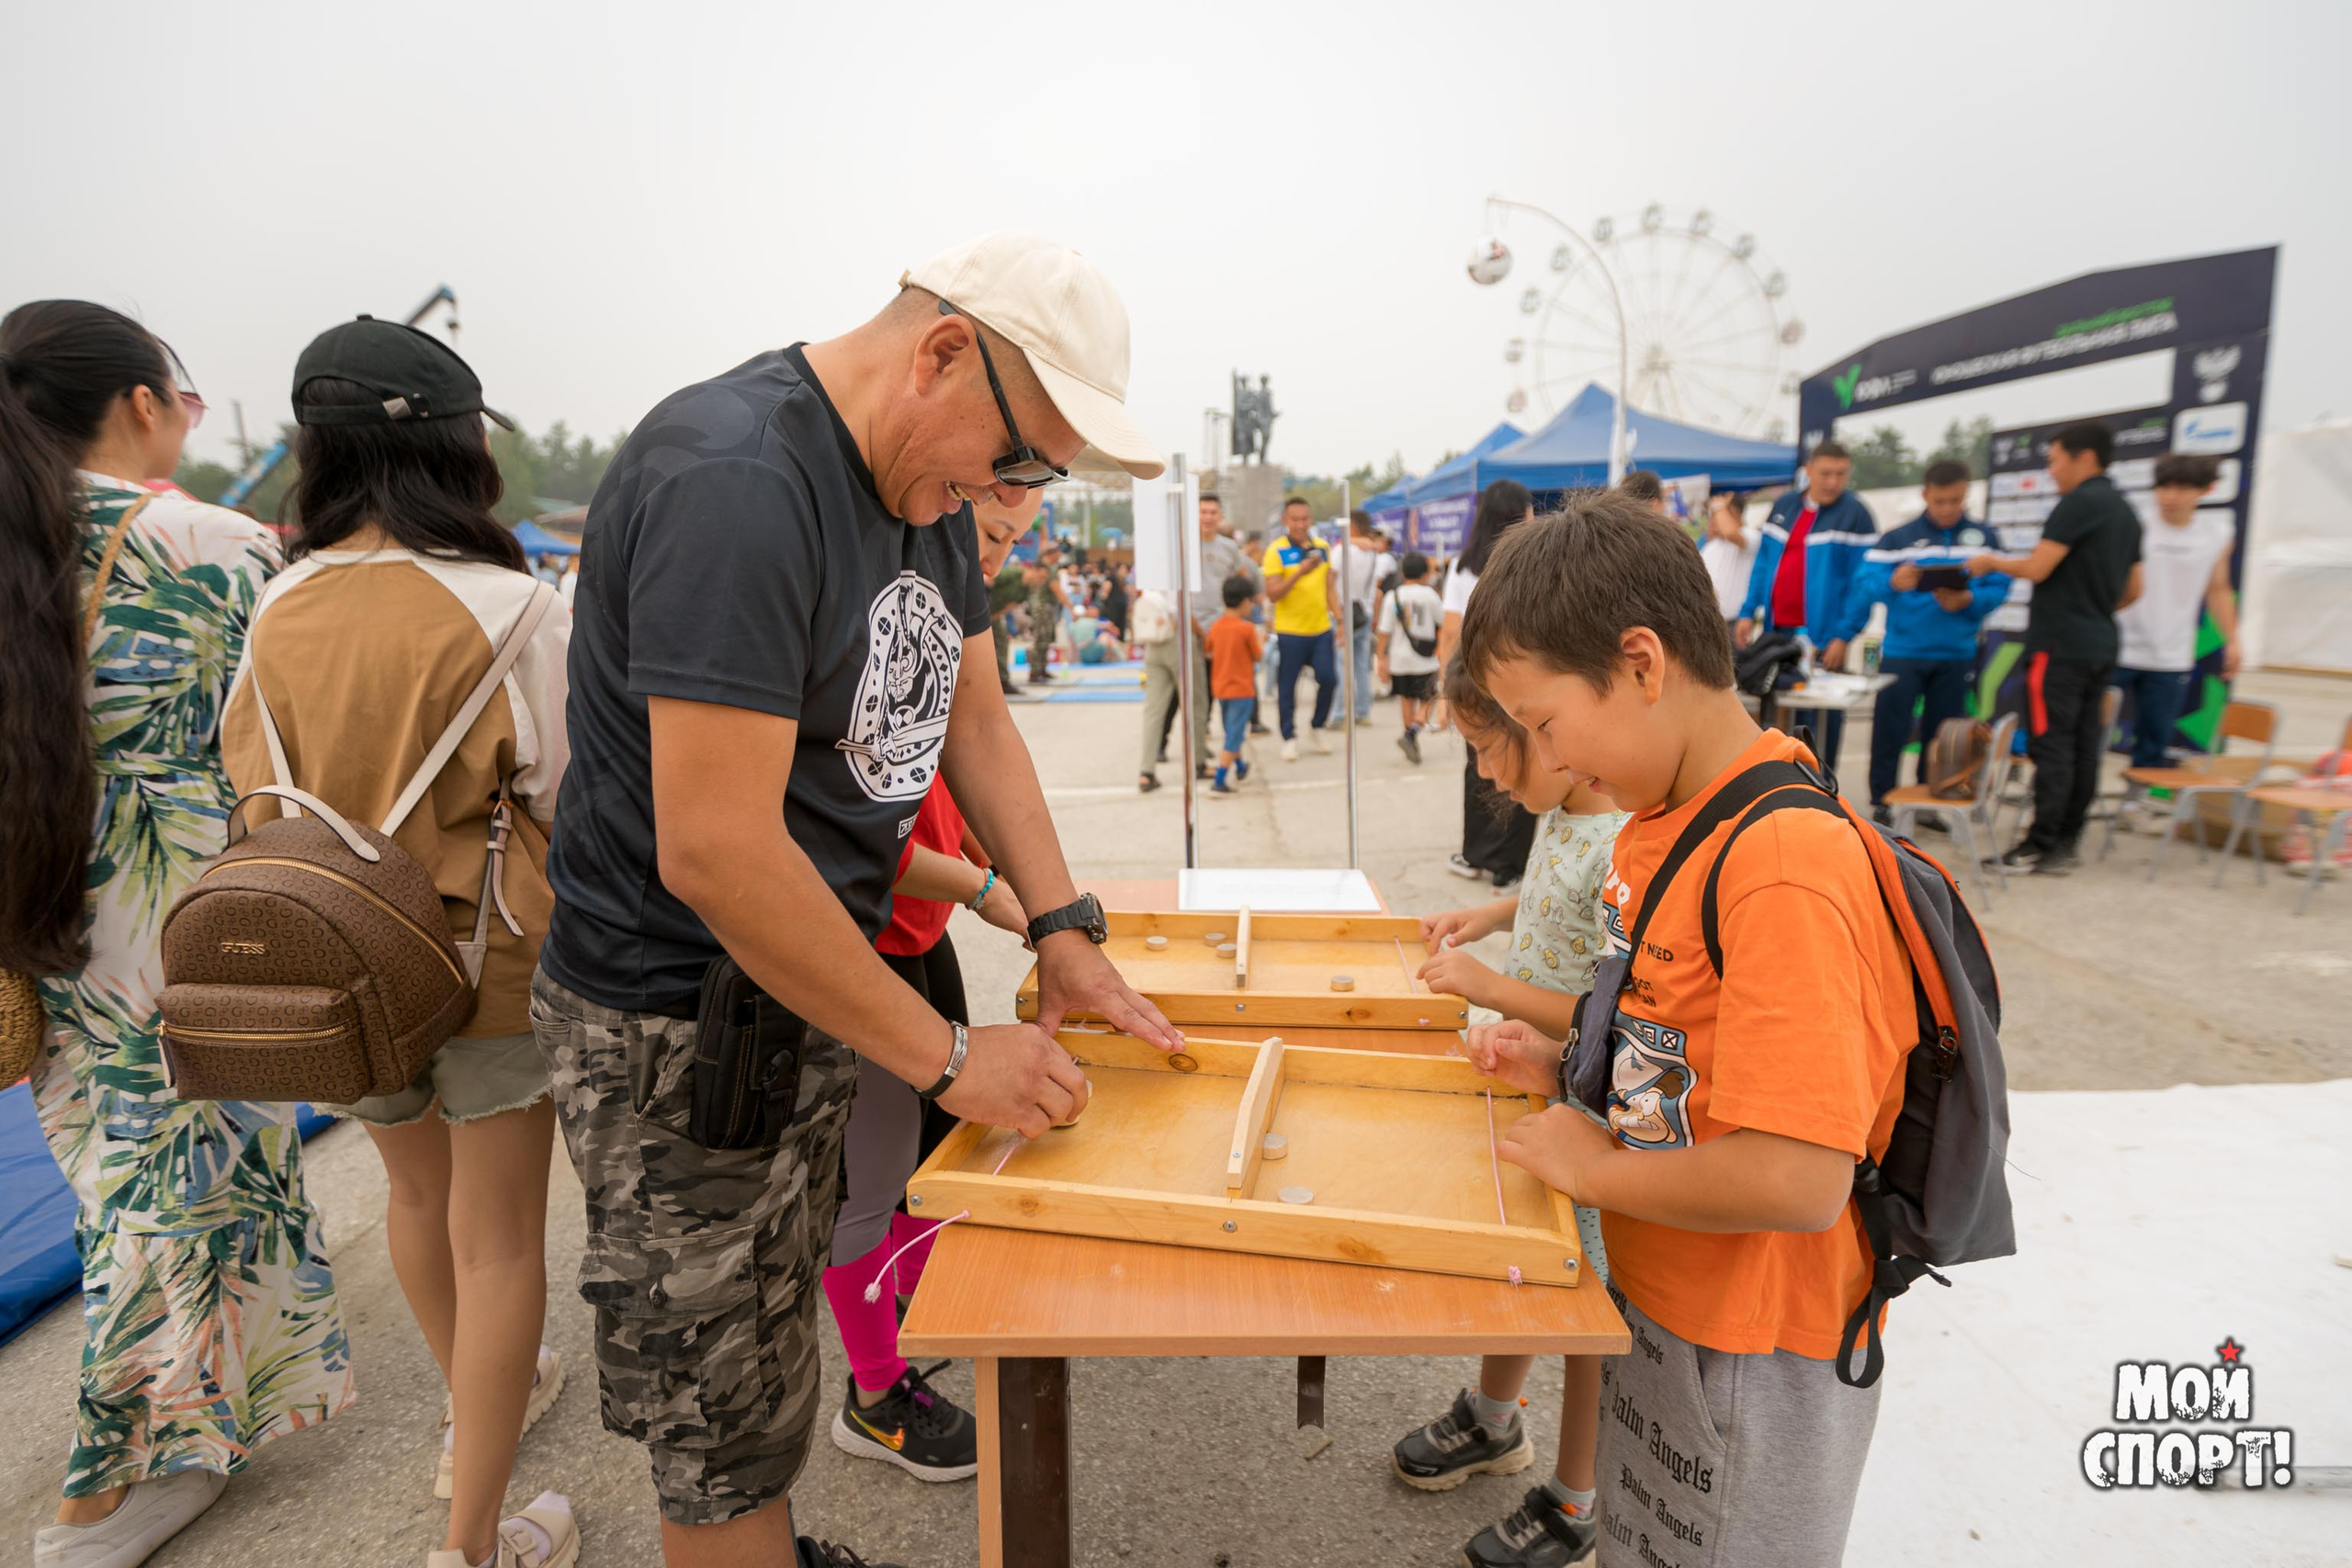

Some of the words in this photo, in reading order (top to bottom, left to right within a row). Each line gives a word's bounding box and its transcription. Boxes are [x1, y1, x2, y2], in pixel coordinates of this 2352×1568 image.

[220, 942, 266, 954] GUESS
[1649, 1421, 1713, 1494] Angels
[1619, 1463, 1652, 1509] Palm
[1656, 1497, 1703, 1547] Angels
